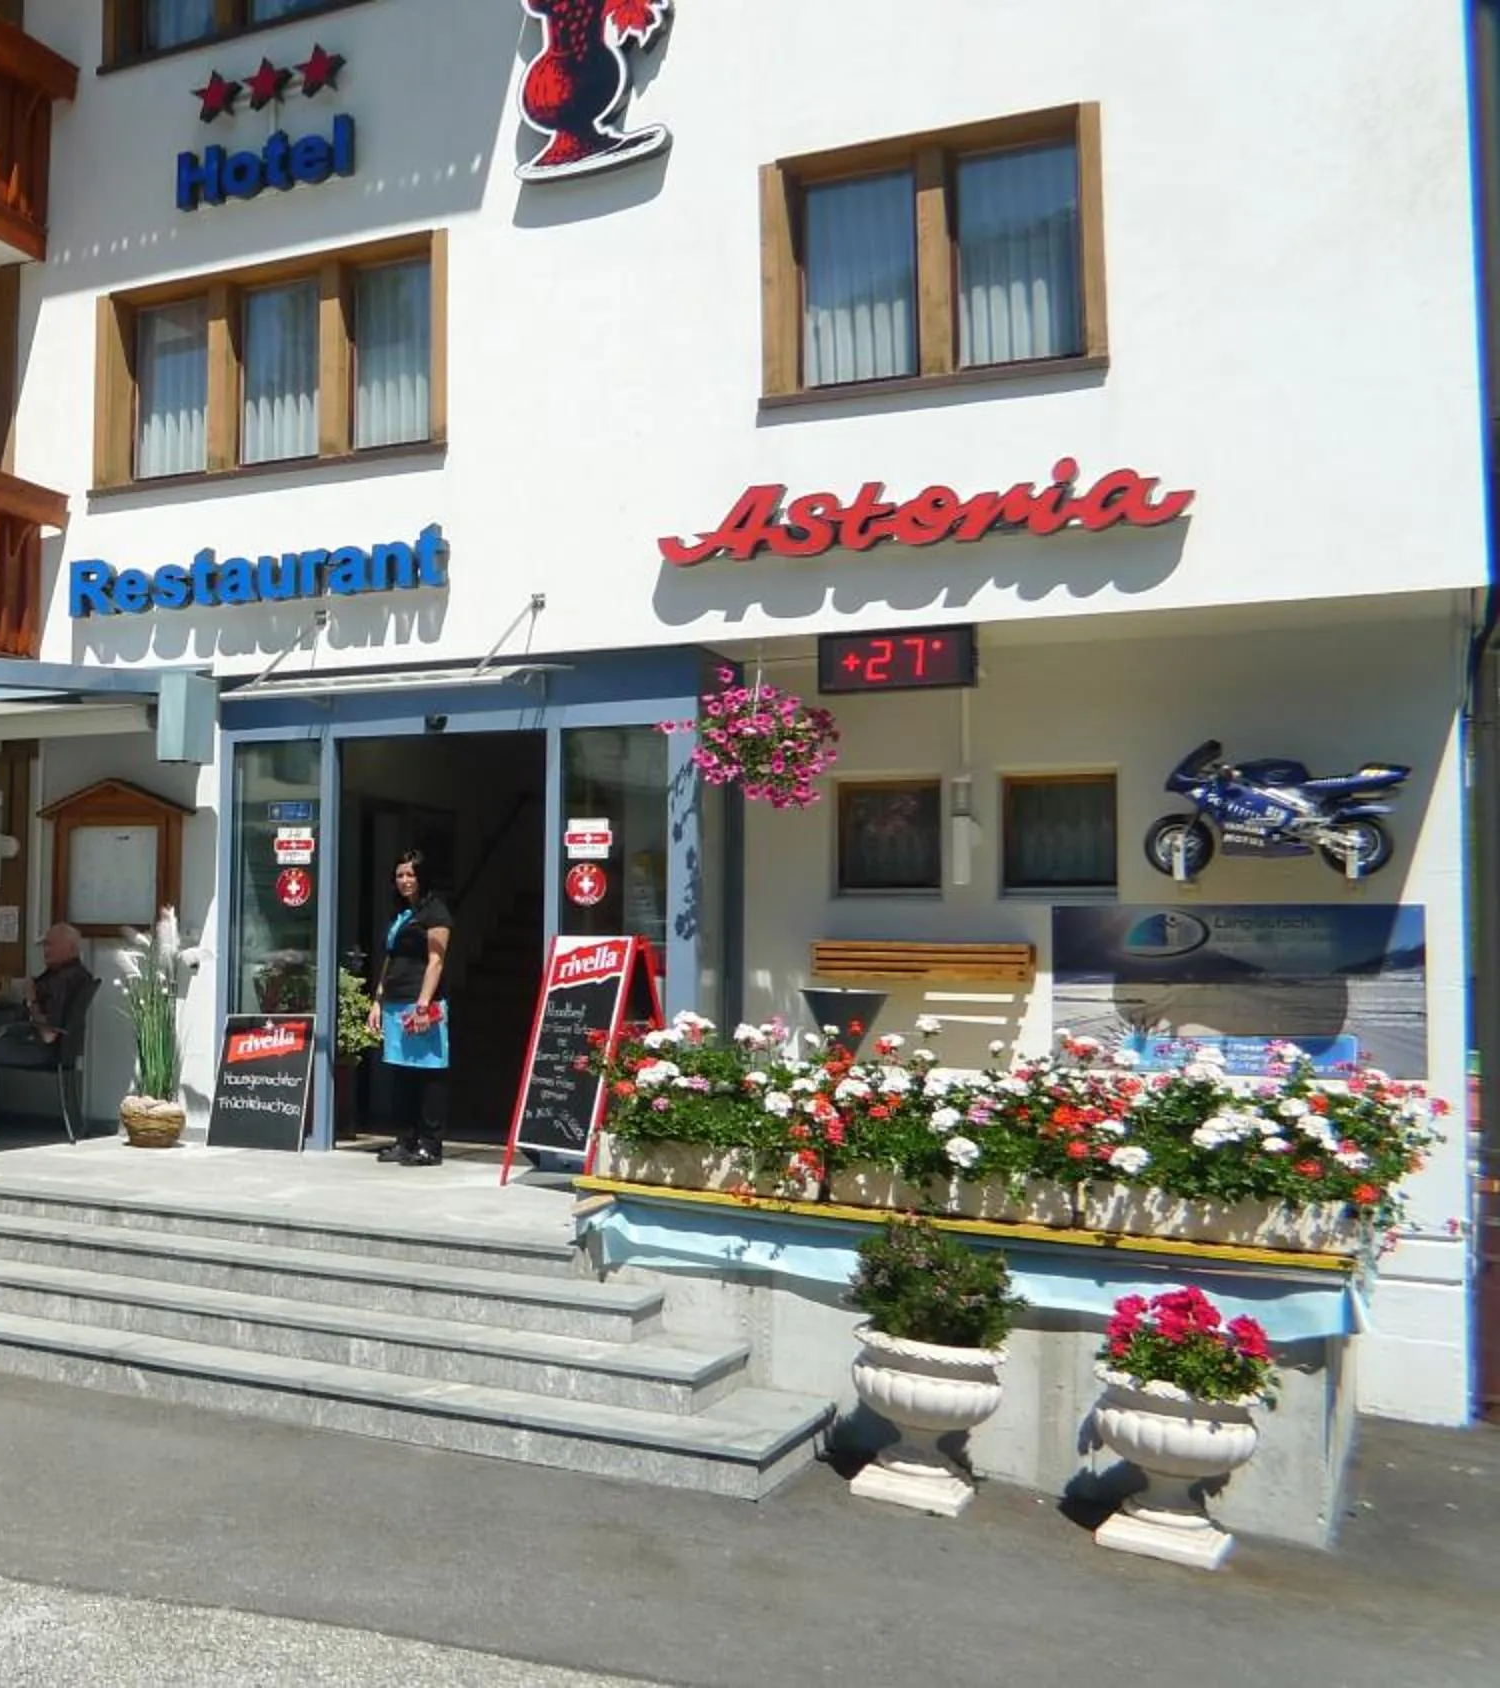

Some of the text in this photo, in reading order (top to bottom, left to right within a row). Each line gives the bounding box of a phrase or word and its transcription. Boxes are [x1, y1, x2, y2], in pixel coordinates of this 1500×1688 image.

[176, 113, 355, 212] Hotel
[658, 457, 1196, 566] Astoria
[69, 523, 449, 618] Restaurant
[559, 945, 619, 979] rivella
[236, 1026, 296, 1055] rivella
